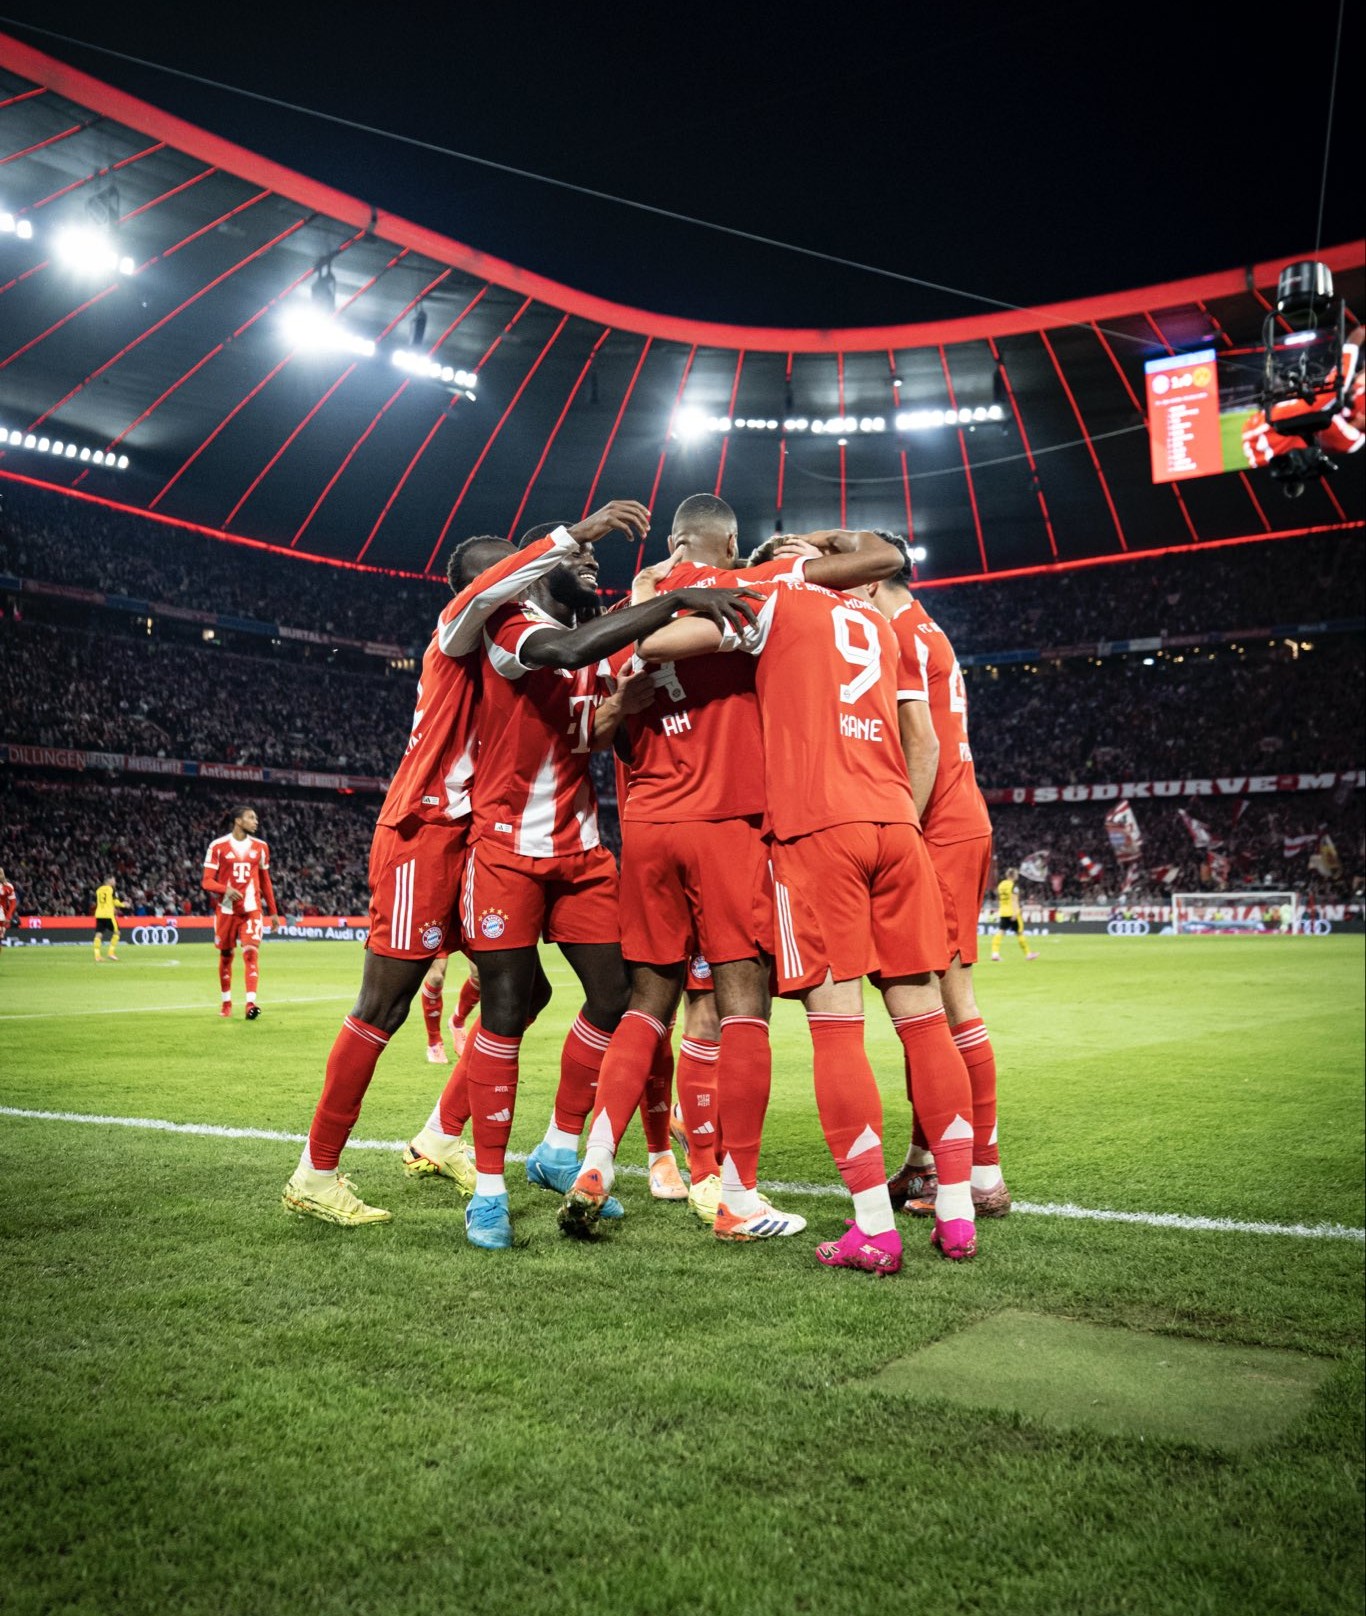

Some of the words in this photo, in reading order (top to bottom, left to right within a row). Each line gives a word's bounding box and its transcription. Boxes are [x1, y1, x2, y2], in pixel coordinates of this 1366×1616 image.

[831, 605, 881, 704] 9
[840, 713, 883, 742] KANE
[9, 747, 85, 769] DILLINGEN
[1033, 775, 1278, 803] SÜDKURVE
[278, 925, 322, 938] neuen
[325, 927, 354, 940] Audi
